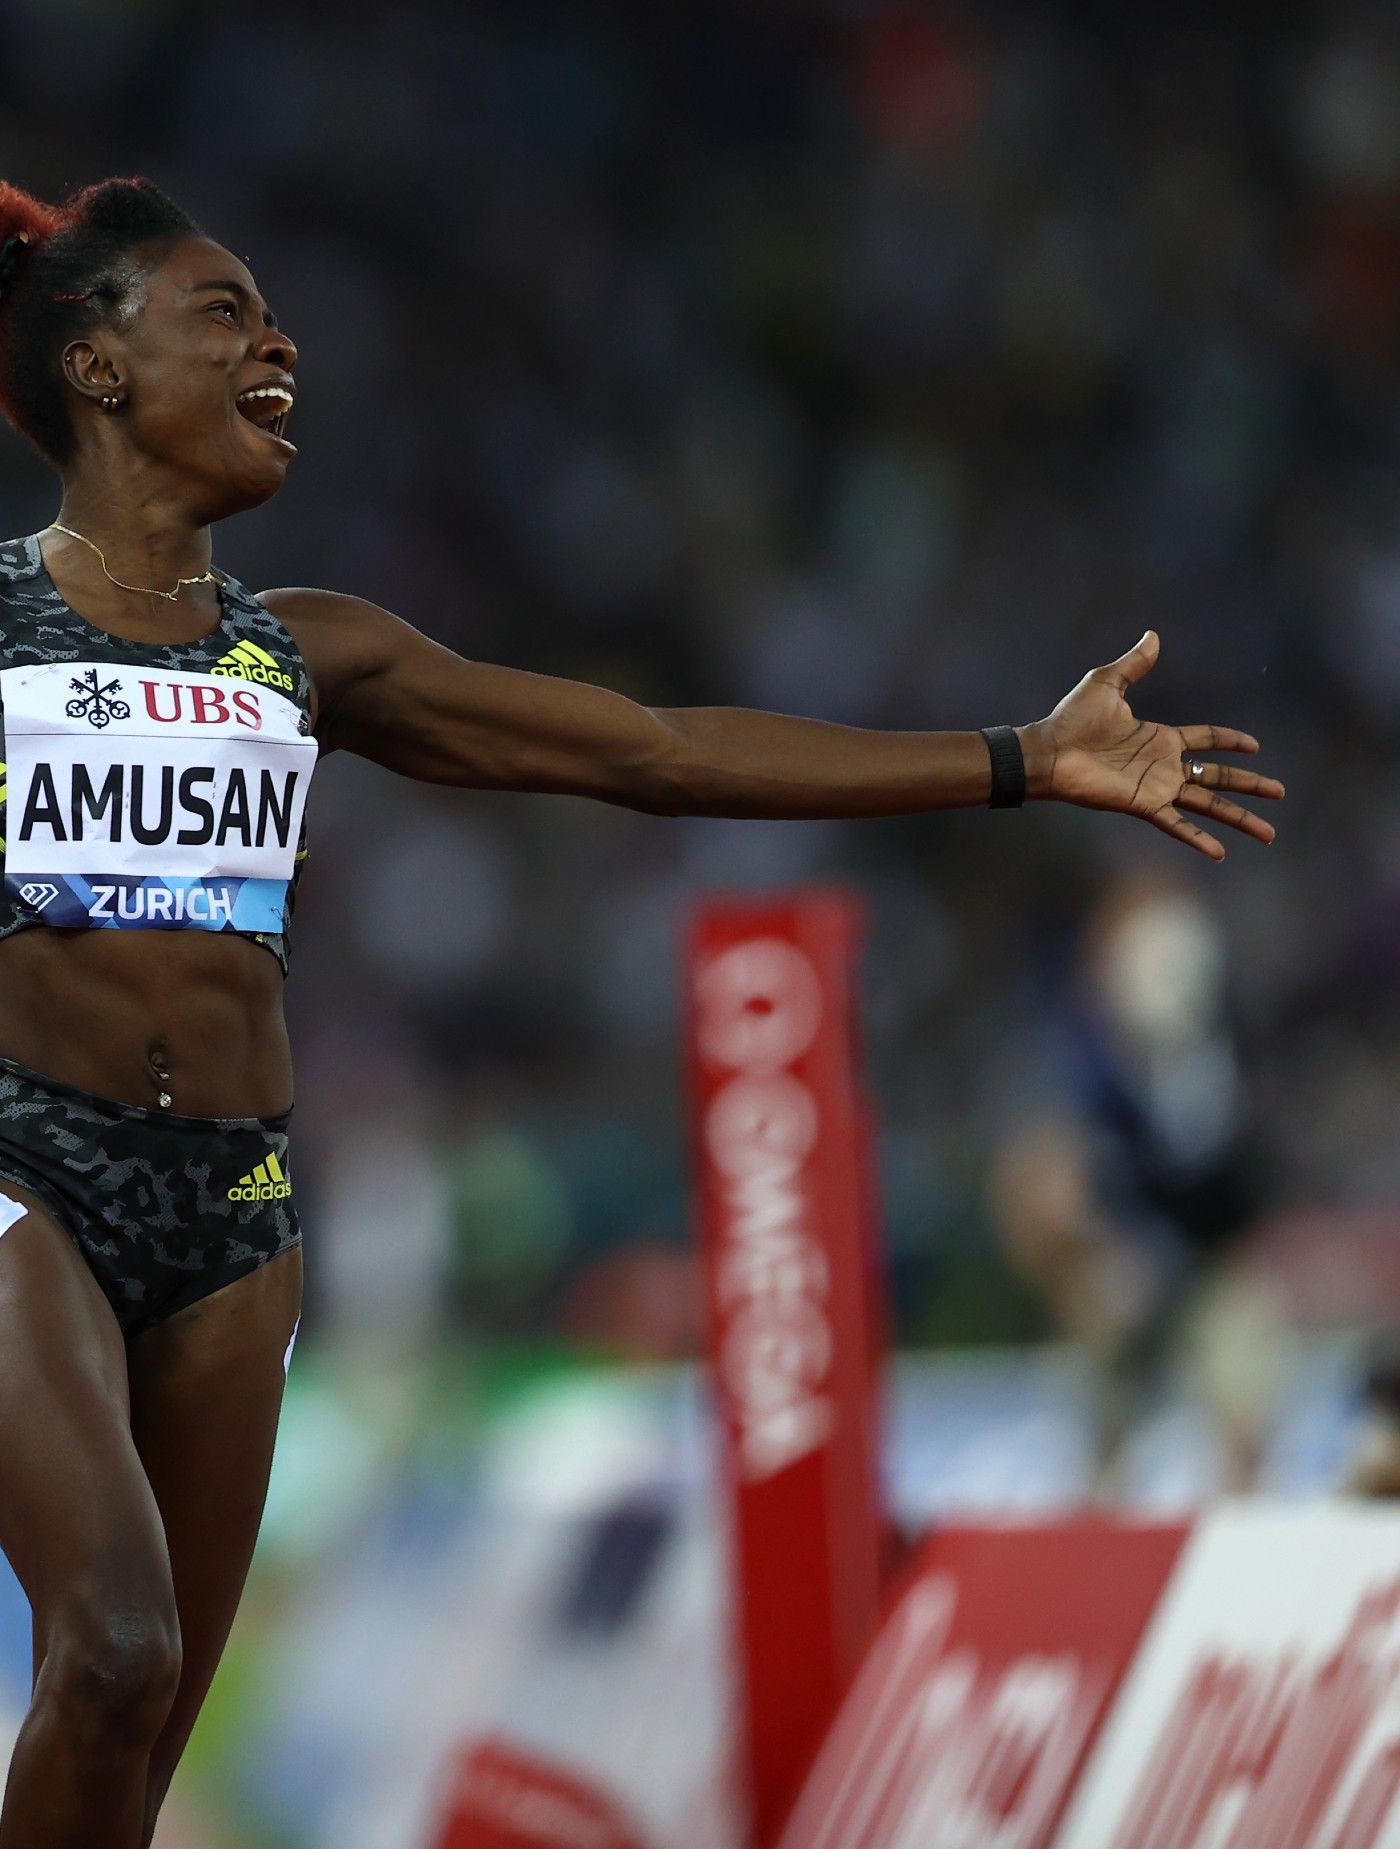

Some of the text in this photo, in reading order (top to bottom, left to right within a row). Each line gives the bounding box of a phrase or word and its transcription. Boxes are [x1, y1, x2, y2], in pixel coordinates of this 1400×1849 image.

[210, 663, 294, 692] adidas
[139, 680, 262, 731] UBS
[18, 762, 299, 849] AMUSAN
[88, 885, 232, 921] ZURICH
[227, 1182, 292, 1201] adidas
